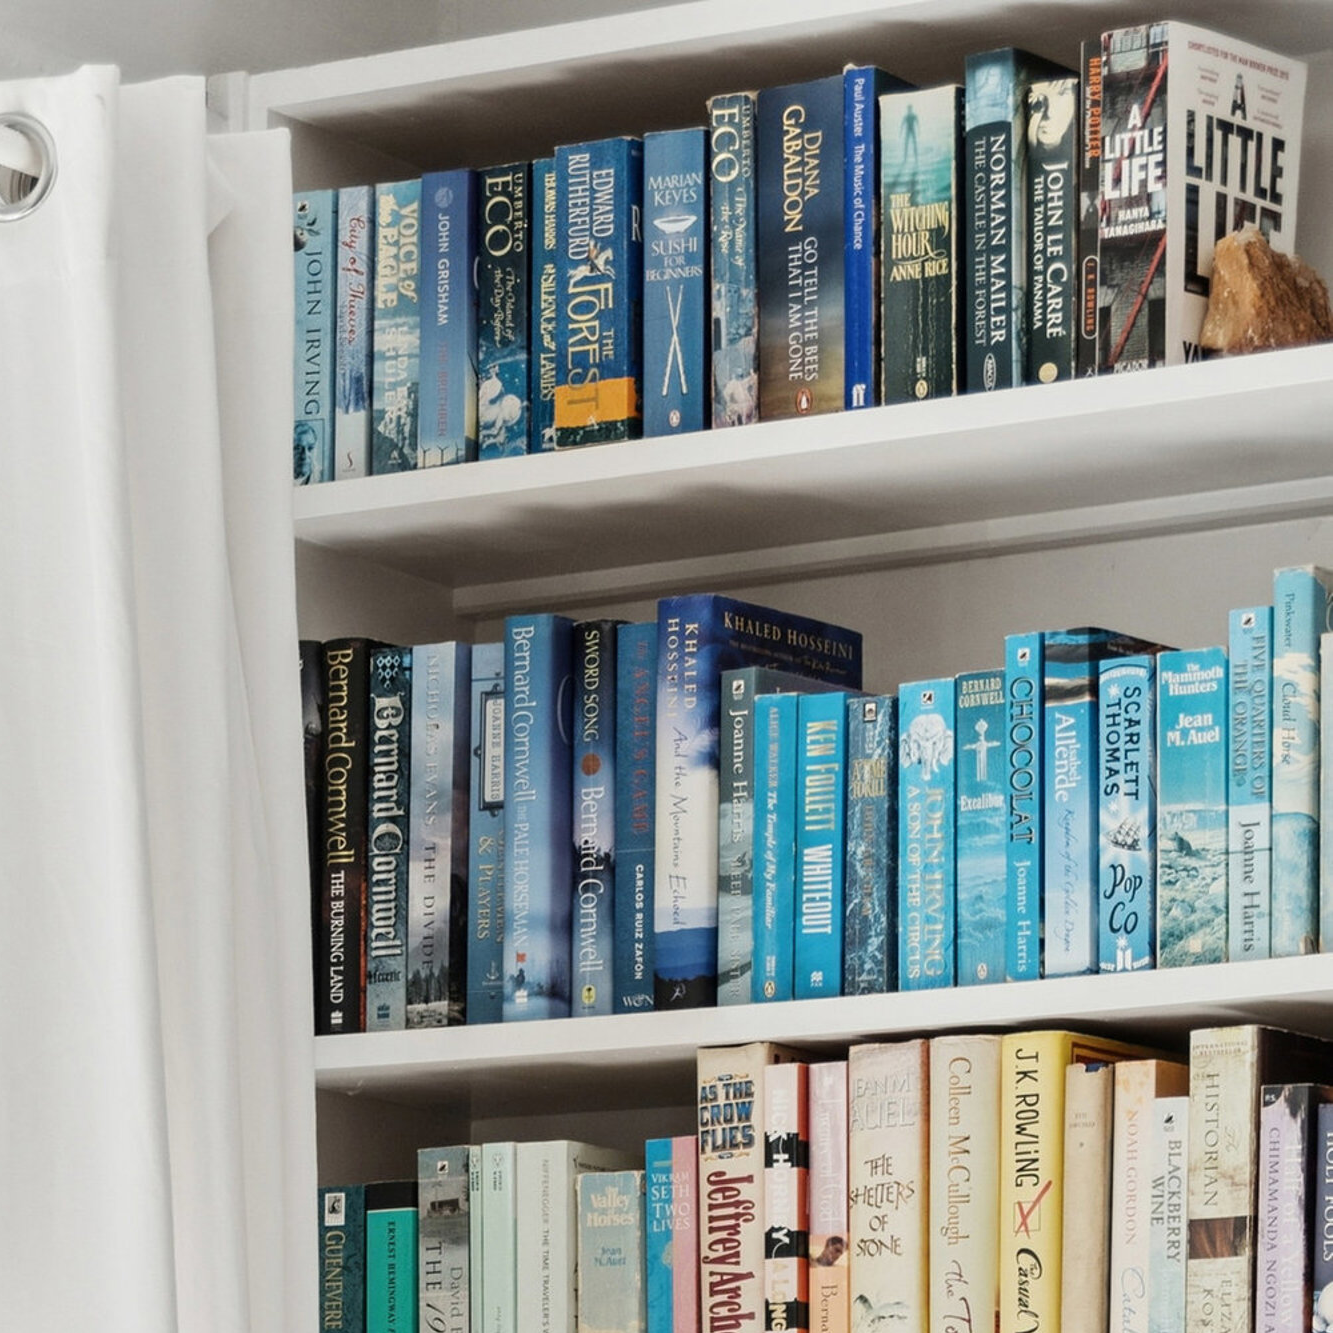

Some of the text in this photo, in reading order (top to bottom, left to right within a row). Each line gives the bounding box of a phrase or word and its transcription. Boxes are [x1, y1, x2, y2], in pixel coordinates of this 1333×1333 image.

[712, 103, 742, 183] ECO
[742, 104, 753, 178] UMBERTO
[852, 78, 866, 250] Paul Auster The Music of Chance
[1104, 127, 1163, 160] LITTLE
[1127, 103, 1142, 129] A
[1185, 109, 1286, 207] LITTLE
[511, 172, 525, 253] UMBERTO
[567, 154, 592, 261] RUTHERFURD
[591, 167, 616, 238] EDWARD
[648, 171, 703, 191] MARIAN
[652, 187, 697, 207] KEYES
[783, 104, 806, 234] GABALDON
[804, 130, 823, 202] DIANA
[1106, 153, 1165, 199] LIFE
[484, 175, 516, 258] ECO
[651, 237, 697, 257] SUSHI
[989, 134, 1007, 346] NORMAN MAILER
[376, 227, 403, 310] EAGLE
[435, 212, 451, 327] JOHN GRISHAM
[302, 250, 324, 417] JOHN IRVING
[602, 326, 615, 363] THE
[512, 626, 536, 803] Bernard Cornwell
[583, 630, 599, 742] SWORD SONG
[684, 621, 699, 711] KHALED
[325, 647, 357, 867] Bernard Cornwell
[1054, 711, 1076, 803] Allende
[1103, 697, 1123, 798] THOMAS
[1122, 685, 1142, 801] SCARLETT
[368, 692, 405, 958] Bernard Cornwell
[801, 719, 838, 936] KEN FOLLETT WHITEOUT
[1010, 676, 1035, 972] CHOCOLAT Joanne Harris
[579, 785, 605, 974] Bernard Cornwell
[1239, 821, 1262, 953] Joanne Harris
[699, 1100, 755, 1128] CROW
[700, 1124, 755, 1155] FLIES
[940, 1056, 972, 1247] Colleen McCullough
[1202, 1072, 1220, 1207] HISTORIAN
[702, 1170, 755, 1268] Jeffrey
[1150, 1175, 1165, 1226] WINE
[1165, 1139, 1182, 1264] BLACKBERRY
[1265, 1127, 1280, 1251] CHIMAMANDA
[325, 1229, 347, 1330] GUENEVERE
[426, 1240, 444, 1291] THE
[1263, 1259, 1279, 1317] NGOZI
